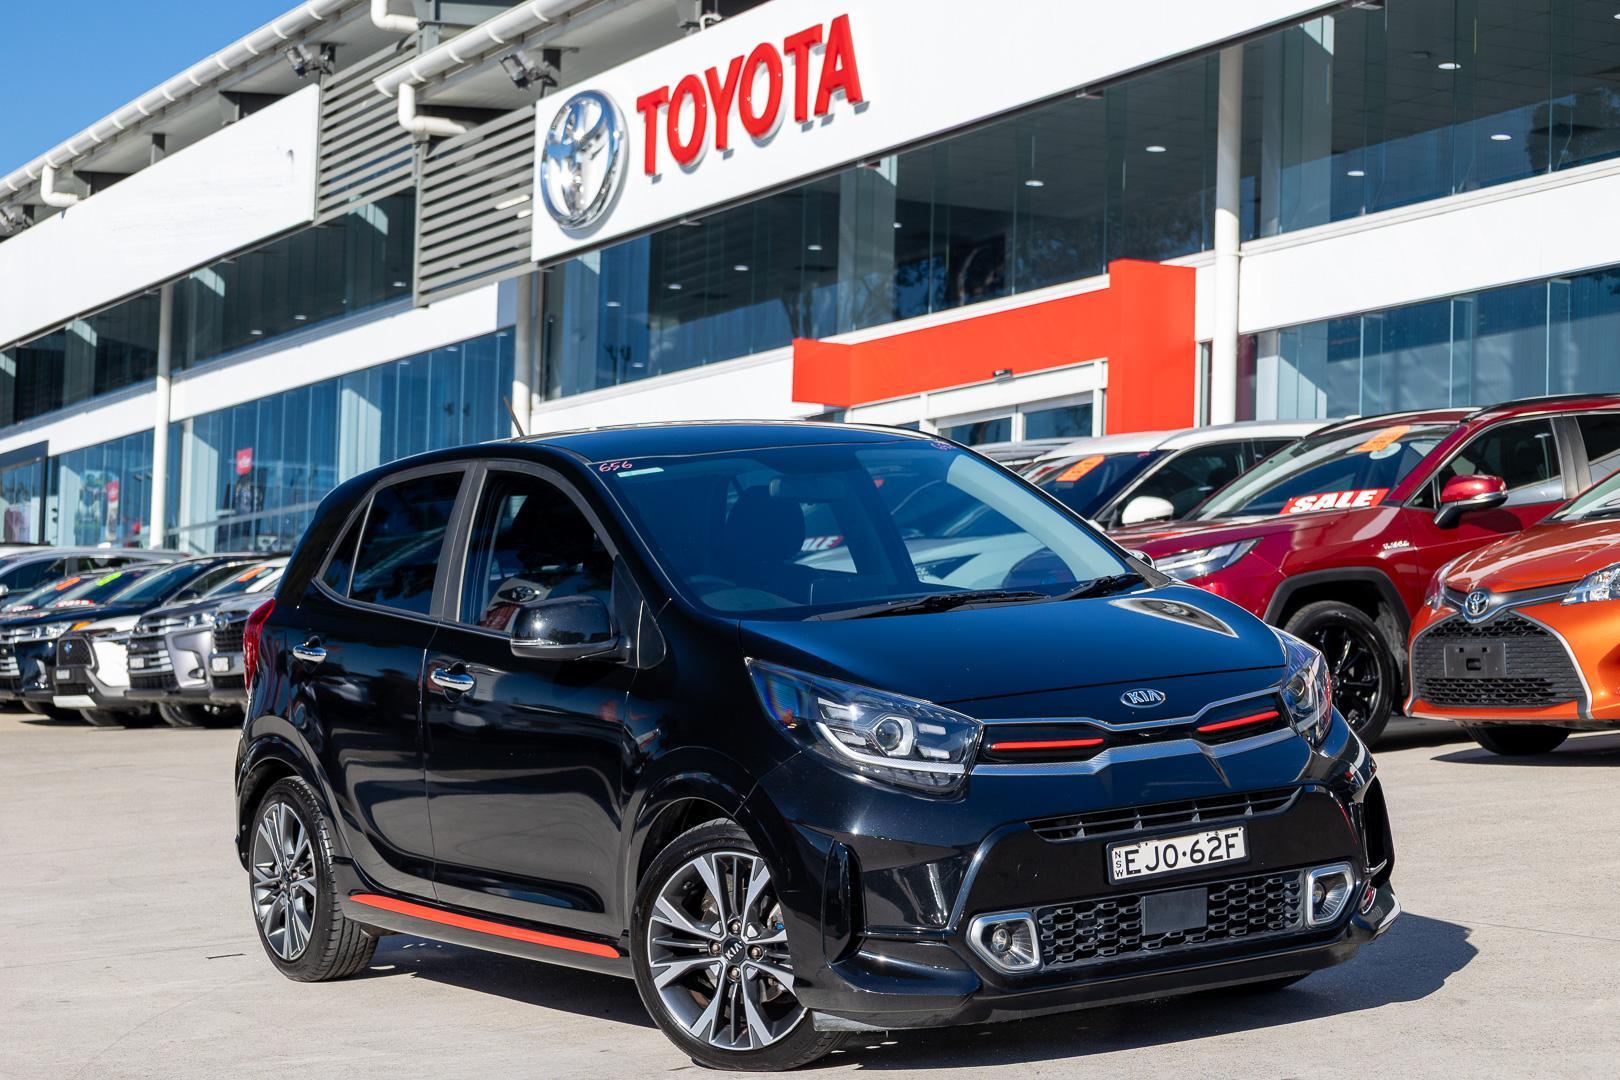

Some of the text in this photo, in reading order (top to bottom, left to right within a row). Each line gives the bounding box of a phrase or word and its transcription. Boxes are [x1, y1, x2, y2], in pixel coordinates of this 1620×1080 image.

[636, 13, 864, 176] TOYOTA
[599, 461, 633, 472] 656
[1290, 490, 1378, 514] SALE
[1127, 690, 1161, 703] KIA
[1114, 851, 1123, 877] NSW
[725, 942, 742, 960] KIA
